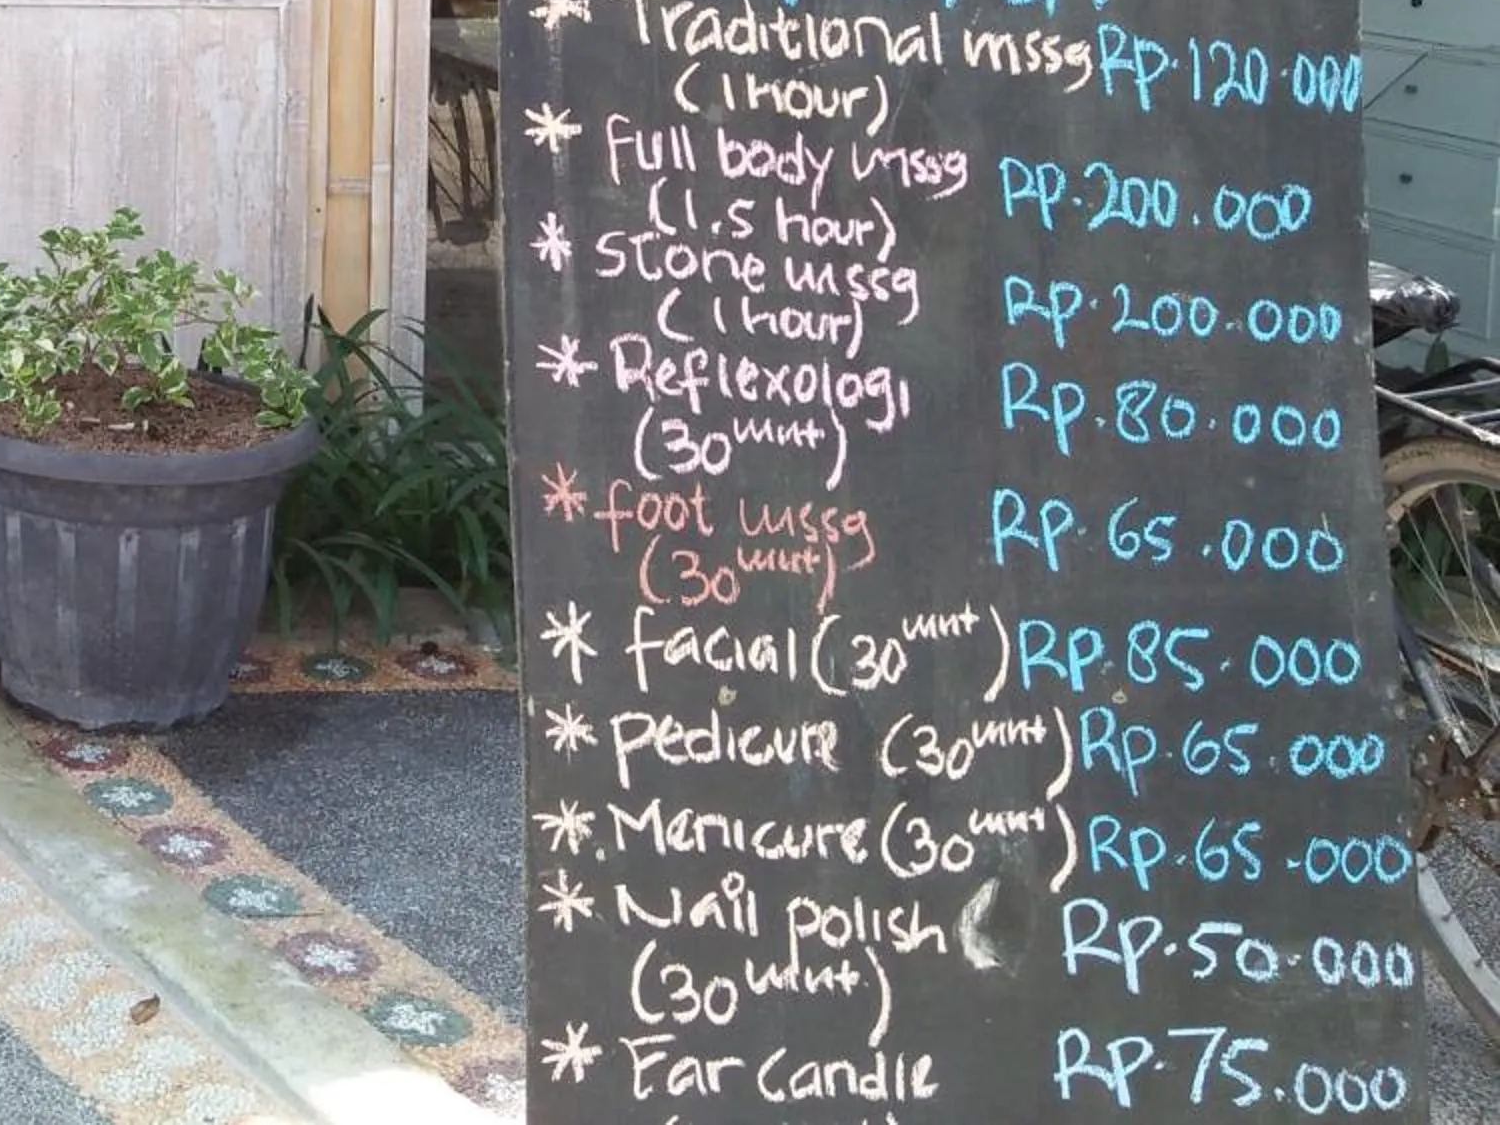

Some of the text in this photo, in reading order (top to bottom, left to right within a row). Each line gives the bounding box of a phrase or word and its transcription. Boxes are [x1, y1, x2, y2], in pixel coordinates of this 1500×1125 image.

[717, 127, 835, 210] body
[615, 871, 758, 937] Nail
[786, 895, 947, 995] polish
[618, 1033, 746, 1101] Ear
